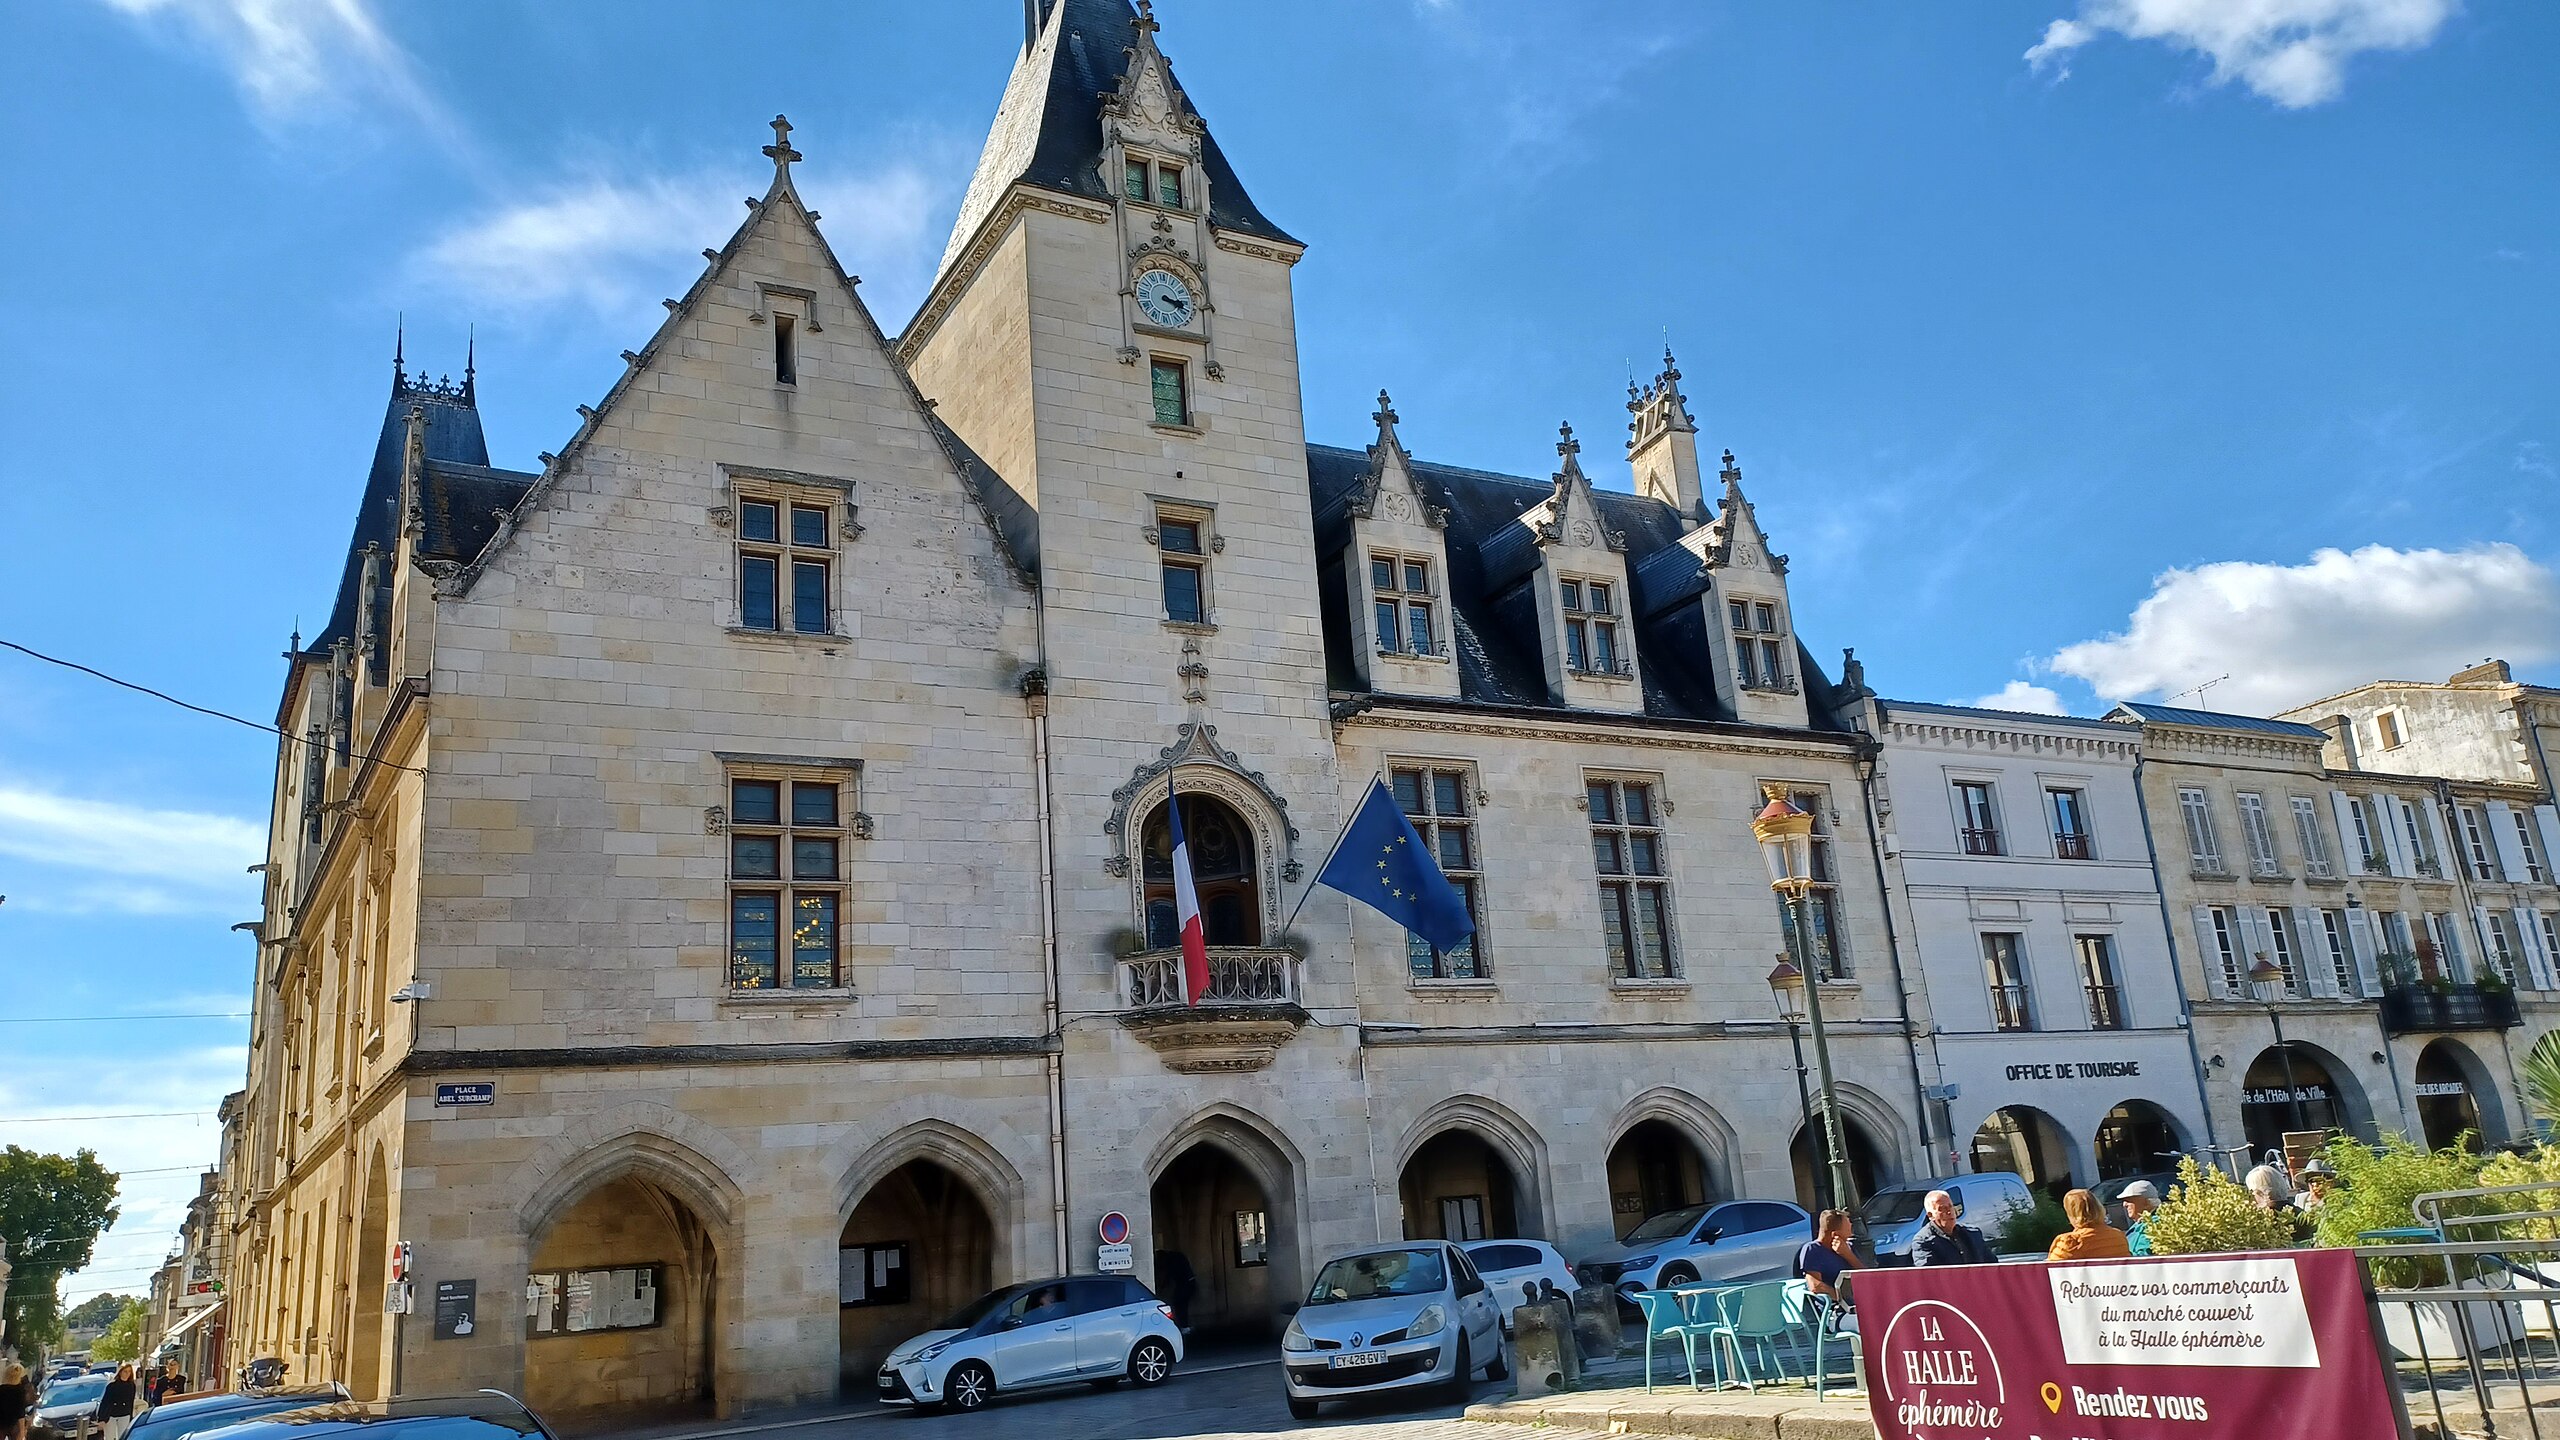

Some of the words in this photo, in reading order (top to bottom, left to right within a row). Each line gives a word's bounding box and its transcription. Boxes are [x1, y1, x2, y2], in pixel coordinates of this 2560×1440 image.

[2005, 1064, 2053, 1081] OFFICE
[2055, 1063, 2075, 1079] DE
[2075, 1061, 2140, 1078] TOURISME
[454, 1086, 477, 1094] PLACE
[2253, 1088, 2265, 1103] de
[2295, 1086, 2306, 1101] de
[2306, 1085, 2326, 1100] Ville
[2060, 1279, 2140, 1303] Retrouvez
[2141, 1283, 2169, 1297] vos
[2172, 1276, 2290, 1298] commerçants
[2101, 1306, 2120, 1323] du
[2122, 1304, 2185, 1322] marché
[2188, 1303, 2254, 1322] couvert
[1919, 1316, 1945, 1341] LA
[2098, 1331, 2110, 1347] à
[2112, 1331, 2127, 1347] la
[2130, 1329, 2179, 1350] Halle
[2181, 1330, 2265, 1351] éphémère
[1902, 1350, 1978, 1385] HALLE
[1898, 1388, 2004, 1435] éphémère
[2071, 1385, 2152, 1419] Rendez
[2151, 1395, 2209, 1421] vous
